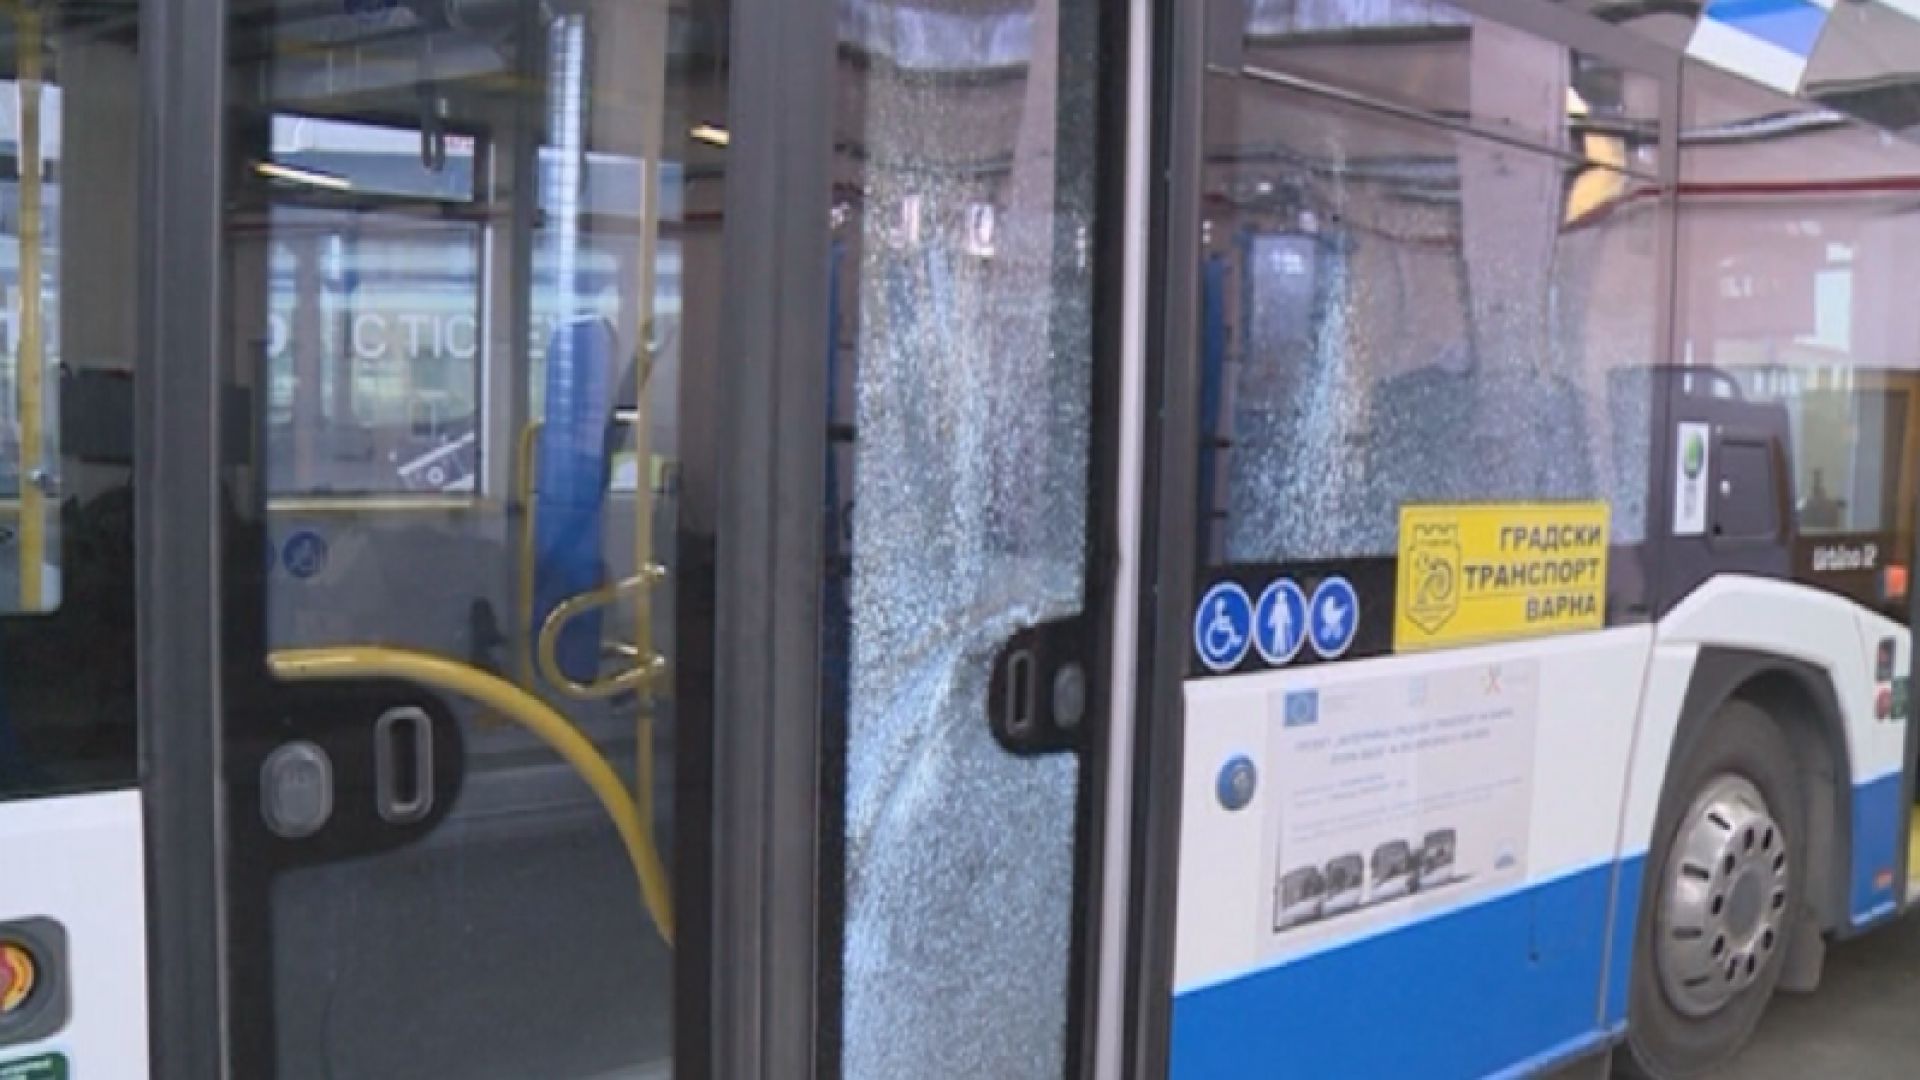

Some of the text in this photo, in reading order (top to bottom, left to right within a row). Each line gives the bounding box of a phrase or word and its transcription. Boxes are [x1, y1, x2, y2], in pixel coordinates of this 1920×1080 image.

[1499, 524, 1602, 552] ГРАДСКИ
[1463, 557, 1601, 593] ТРАНСПОРТ
[1525, 592, 1597, 624] ВАРНА
